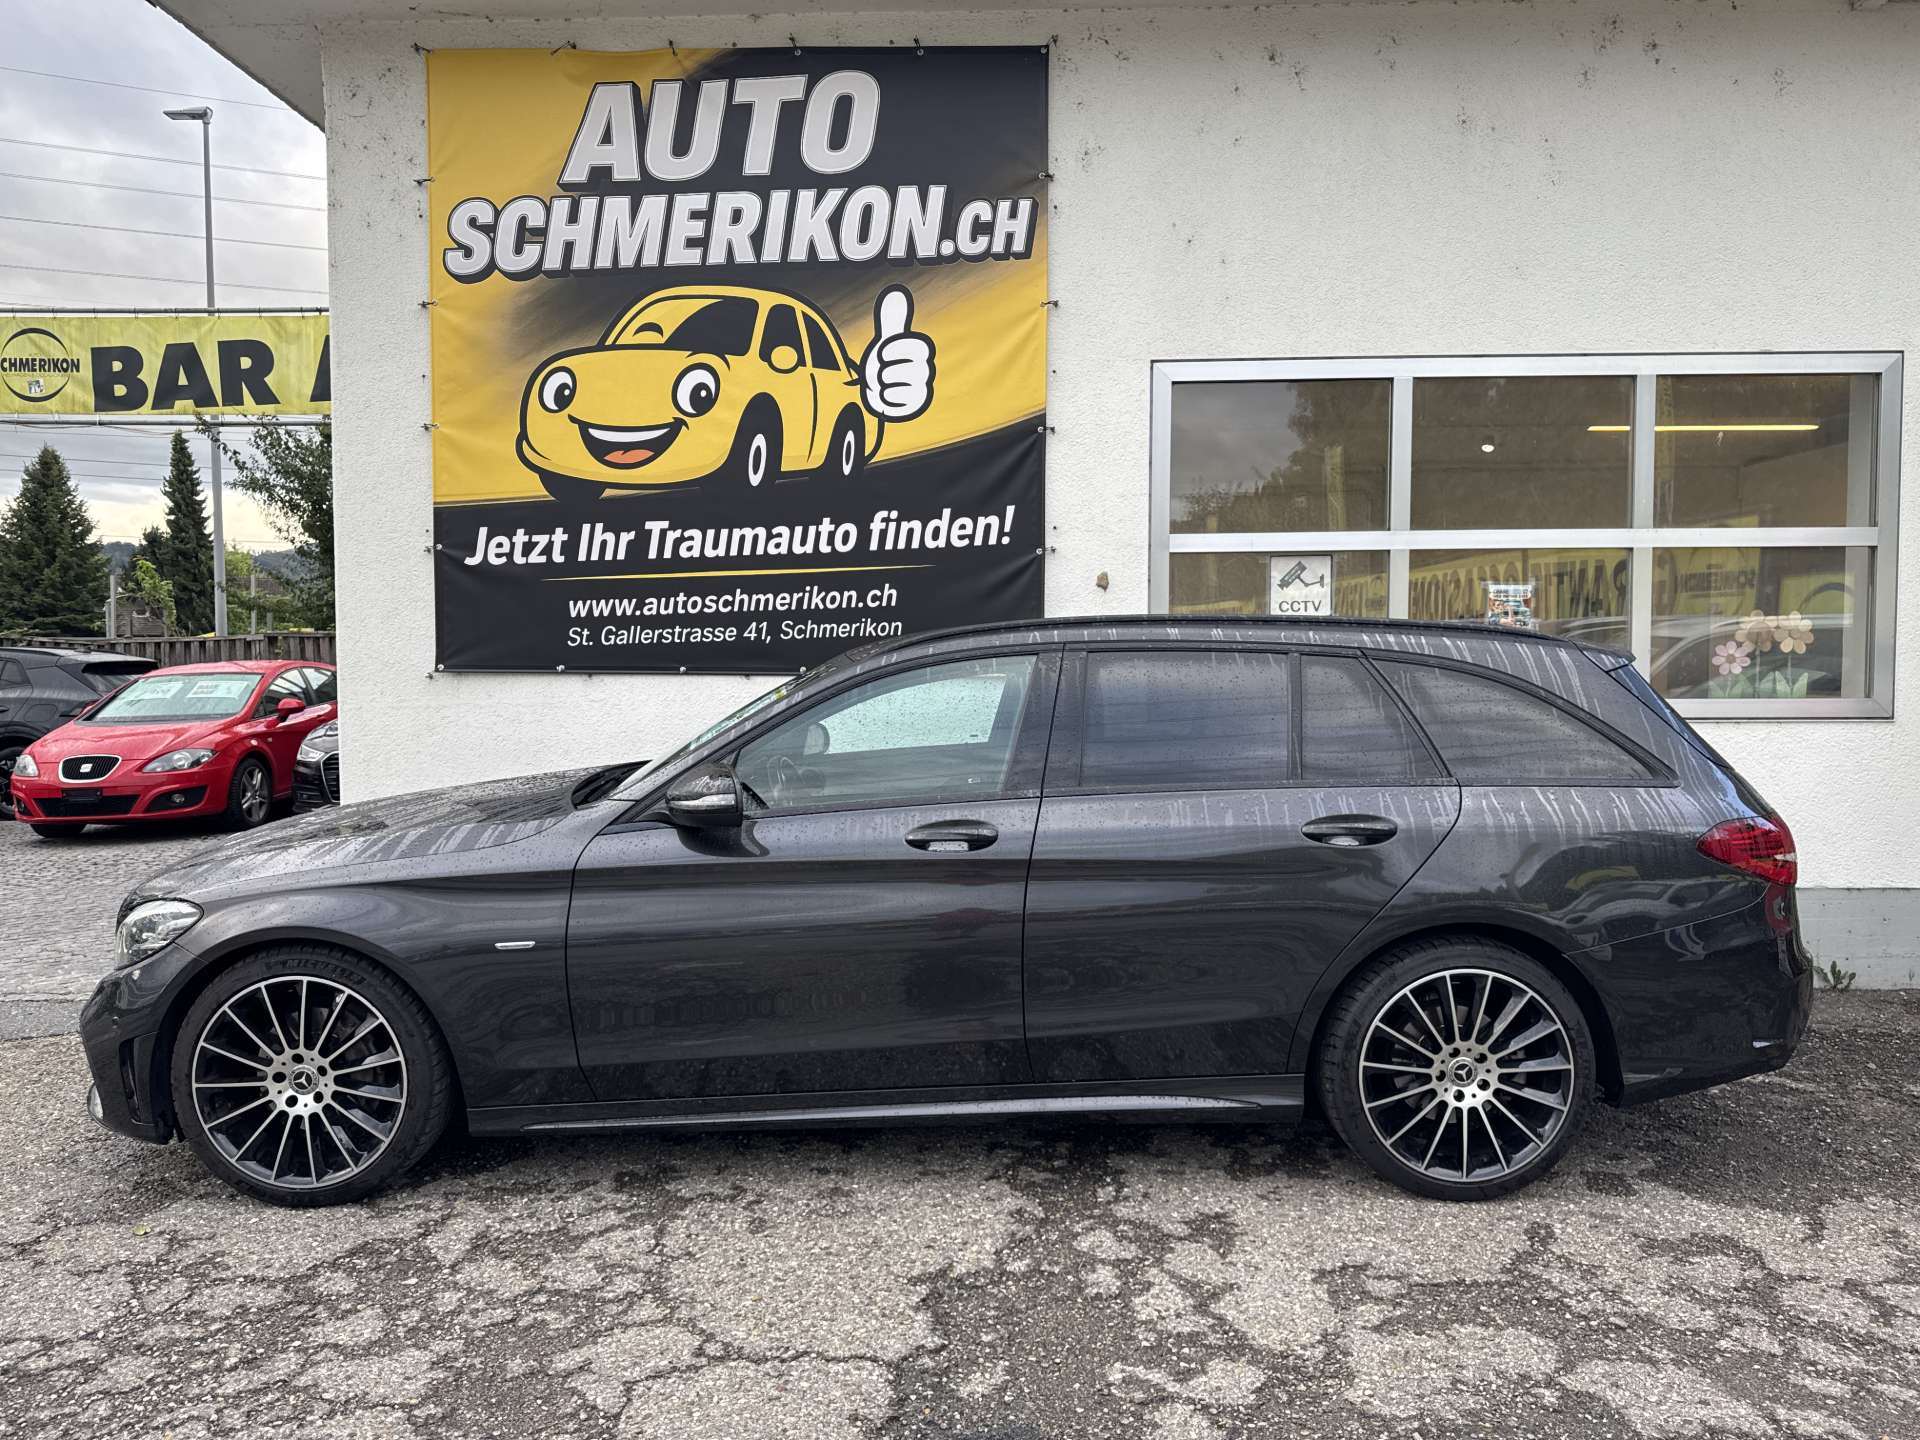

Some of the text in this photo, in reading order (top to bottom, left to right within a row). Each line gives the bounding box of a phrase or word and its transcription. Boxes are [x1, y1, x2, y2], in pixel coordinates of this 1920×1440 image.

[558, 68, 881, 190] AUTO
[444, 184, 1037, 283] SCHMERIKON.CH
[90, 339, 281, 413] BAR
[463, 504, 1016, 566] Jetzt Ihr Traumauto finden!
[568, 583, 898, 618] www.autoschmerikon.ch
[1278, 599, 1323, 613] CCTV
[567, 617, 903, 647] St. Gallerstrasse 41, Schmerikon
